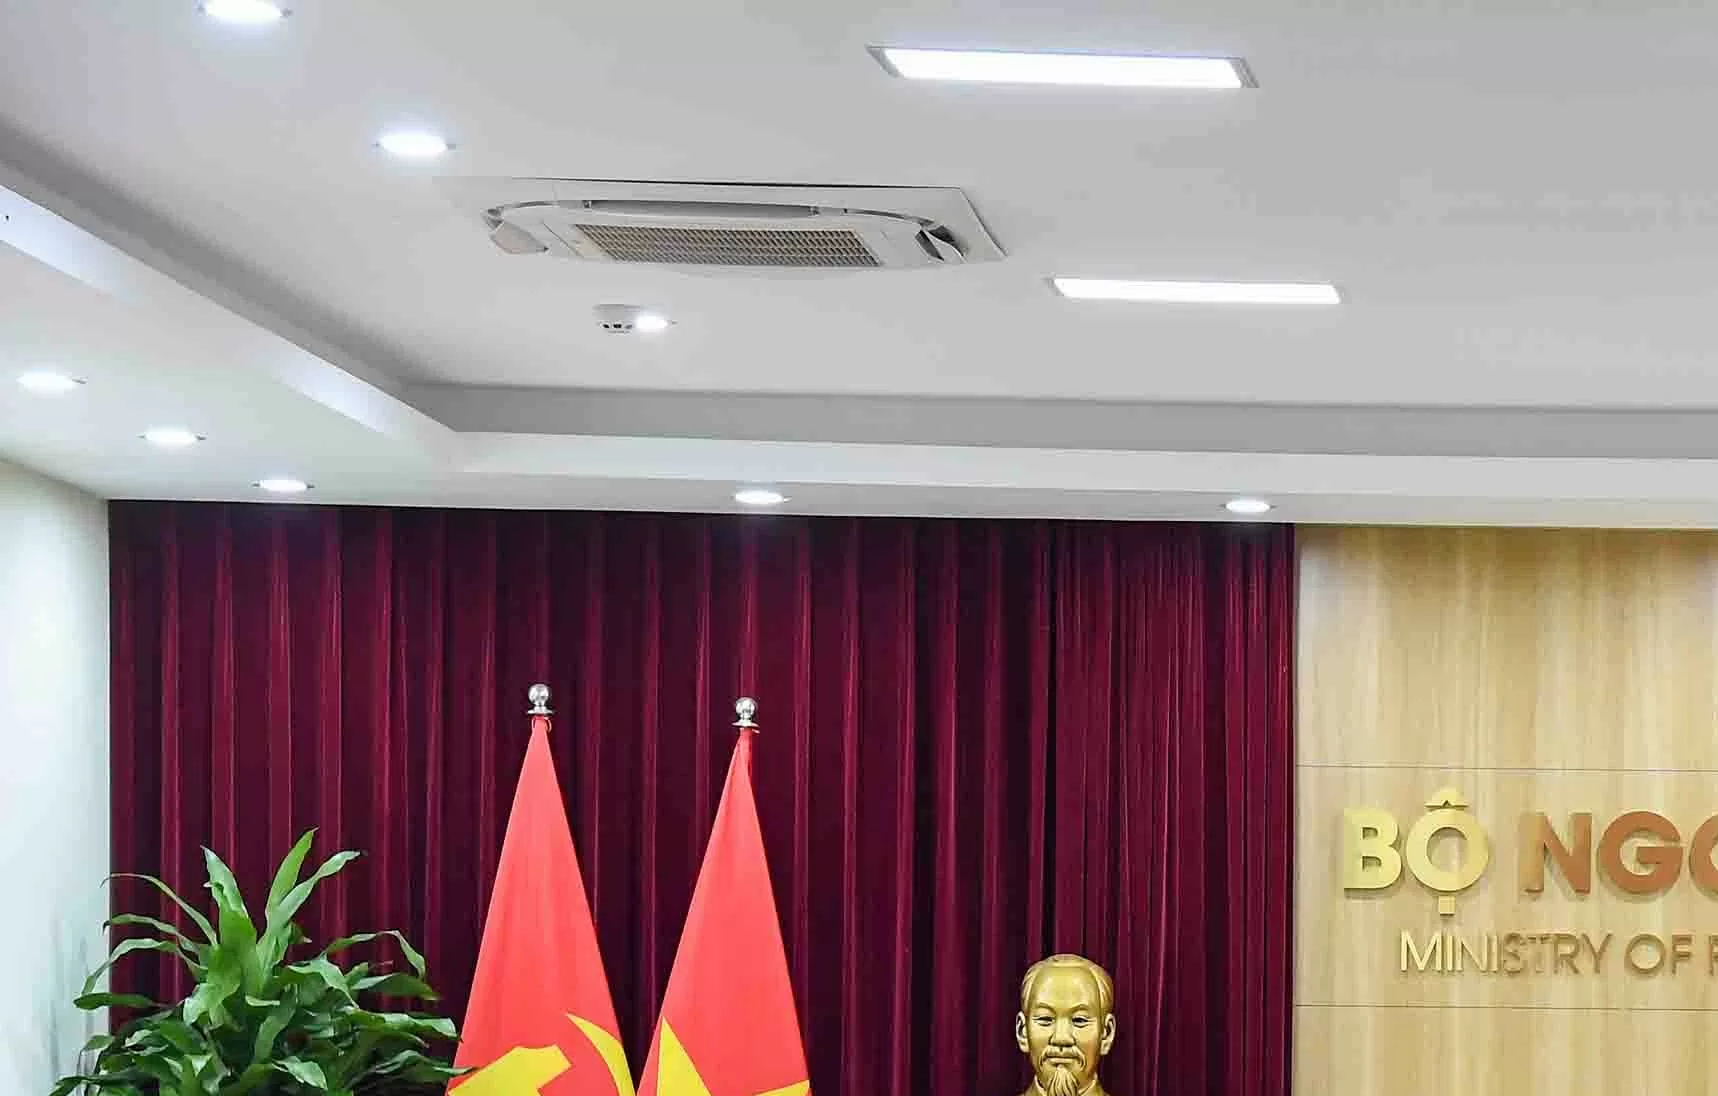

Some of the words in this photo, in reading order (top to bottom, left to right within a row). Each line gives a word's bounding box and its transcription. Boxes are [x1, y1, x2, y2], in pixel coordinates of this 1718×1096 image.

[1343, 789, 1490, 916] BỘ
[1399, 929, 1612, 975] MINISTRY
[1623, 932, 1696, 976] OF
